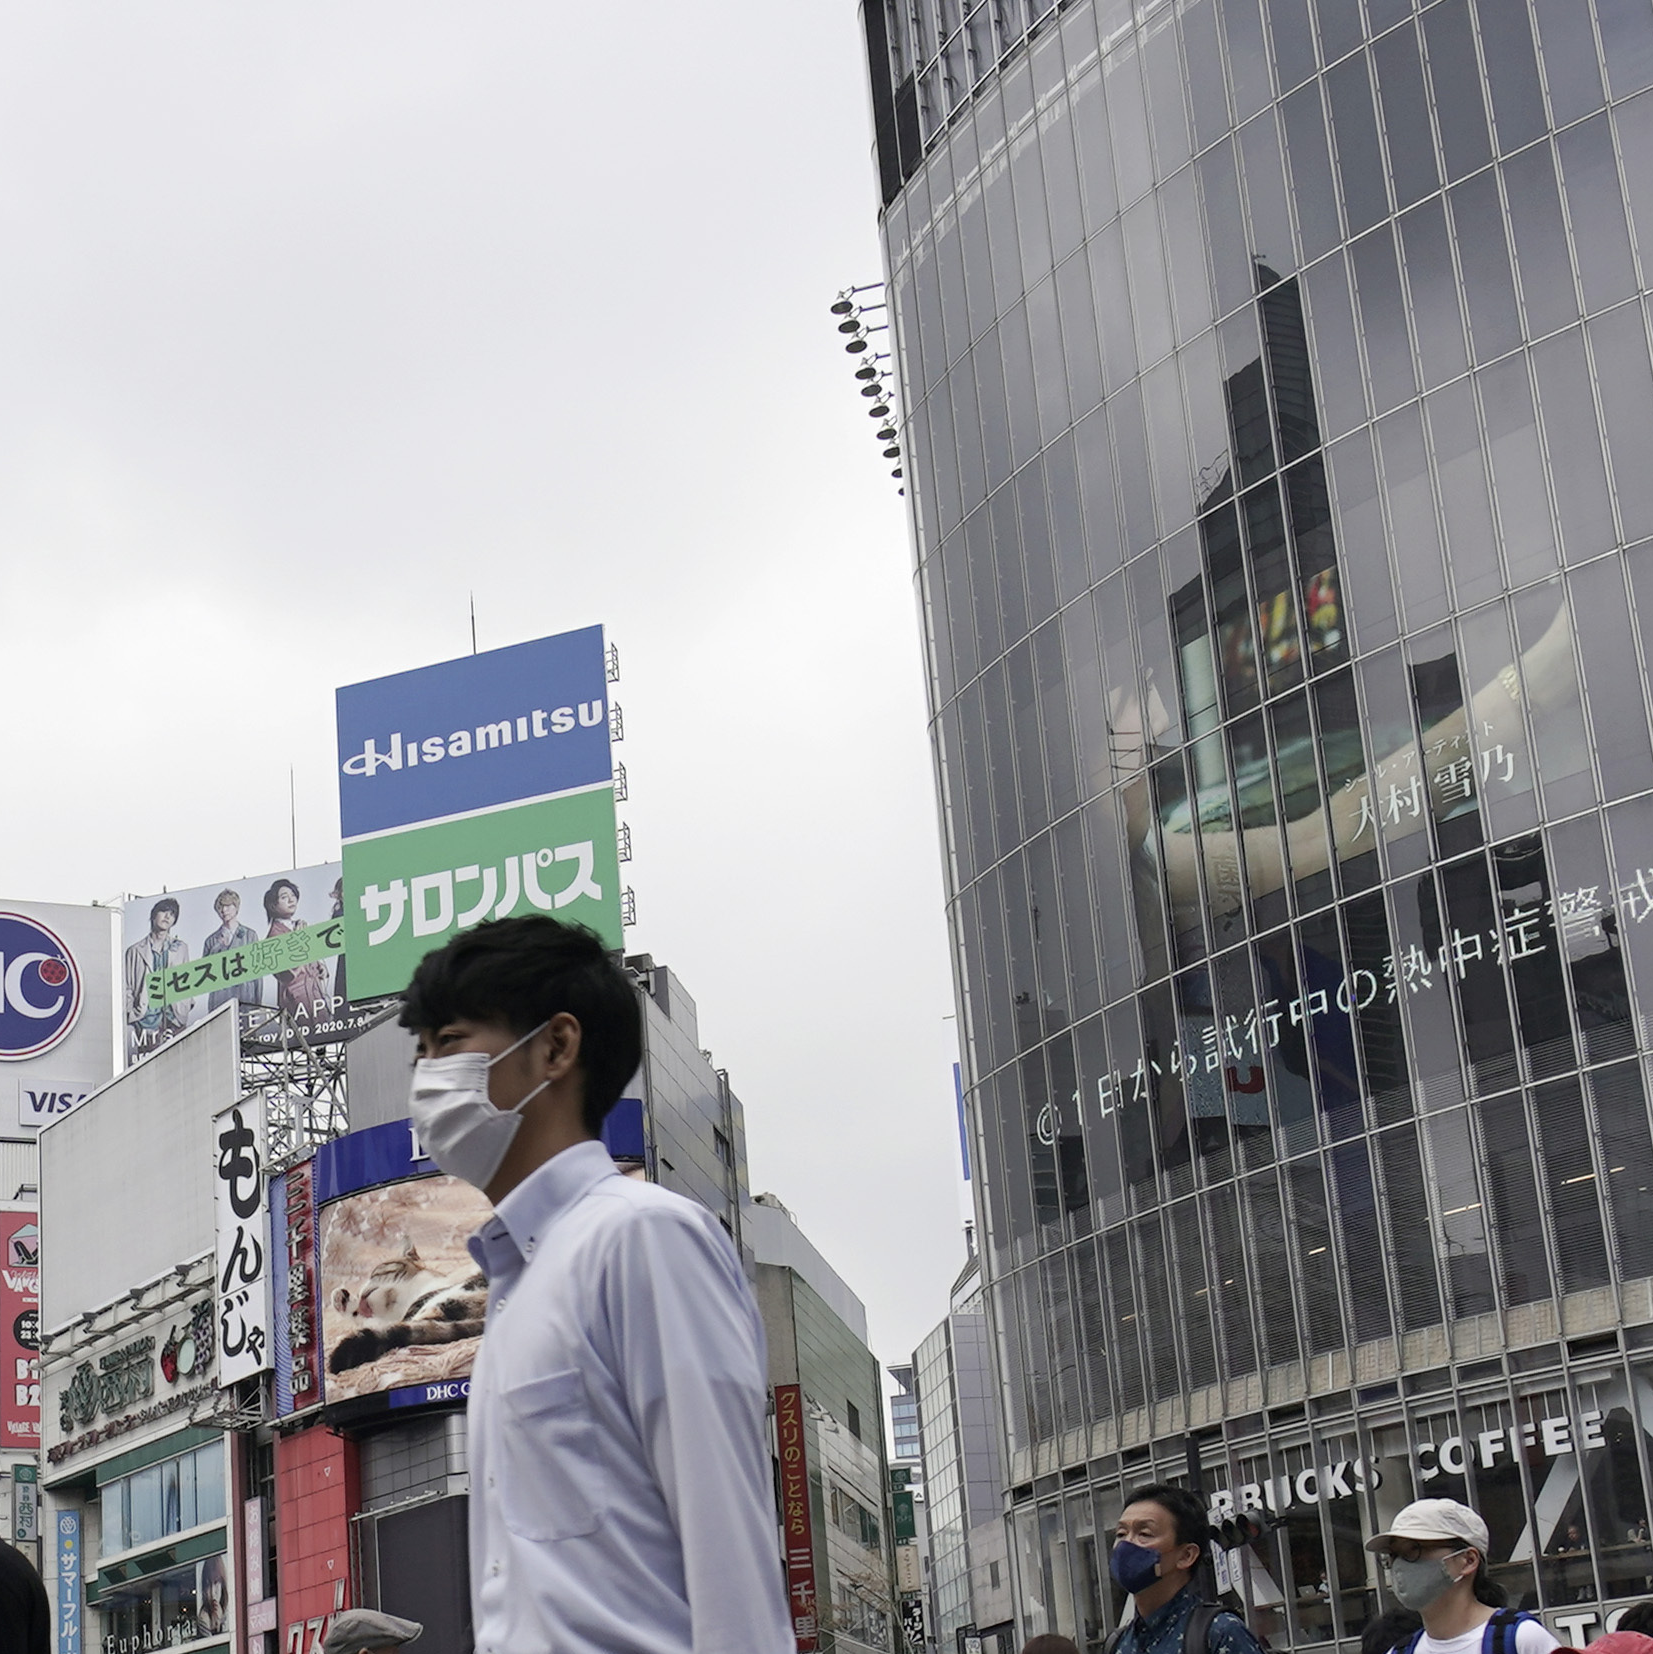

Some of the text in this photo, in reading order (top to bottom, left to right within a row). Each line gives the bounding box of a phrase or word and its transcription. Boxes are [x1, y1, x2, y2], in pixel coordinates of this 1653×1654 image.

[342, 699, 606, 778] Hisamitsu
[360, 839, 603, 948] サロンパス
[148, 922, 345, 1001] ミセスは好きで
[218, 1108, 267, 1367] もんじゃ
[425, 1383, 459, 1402] DHC
[779, 1392, 806, 1535] クスリのことなら
[1410, 1410, 1607, 1481] COFFEE
[789, 1548, 818, 1640] 三千里
